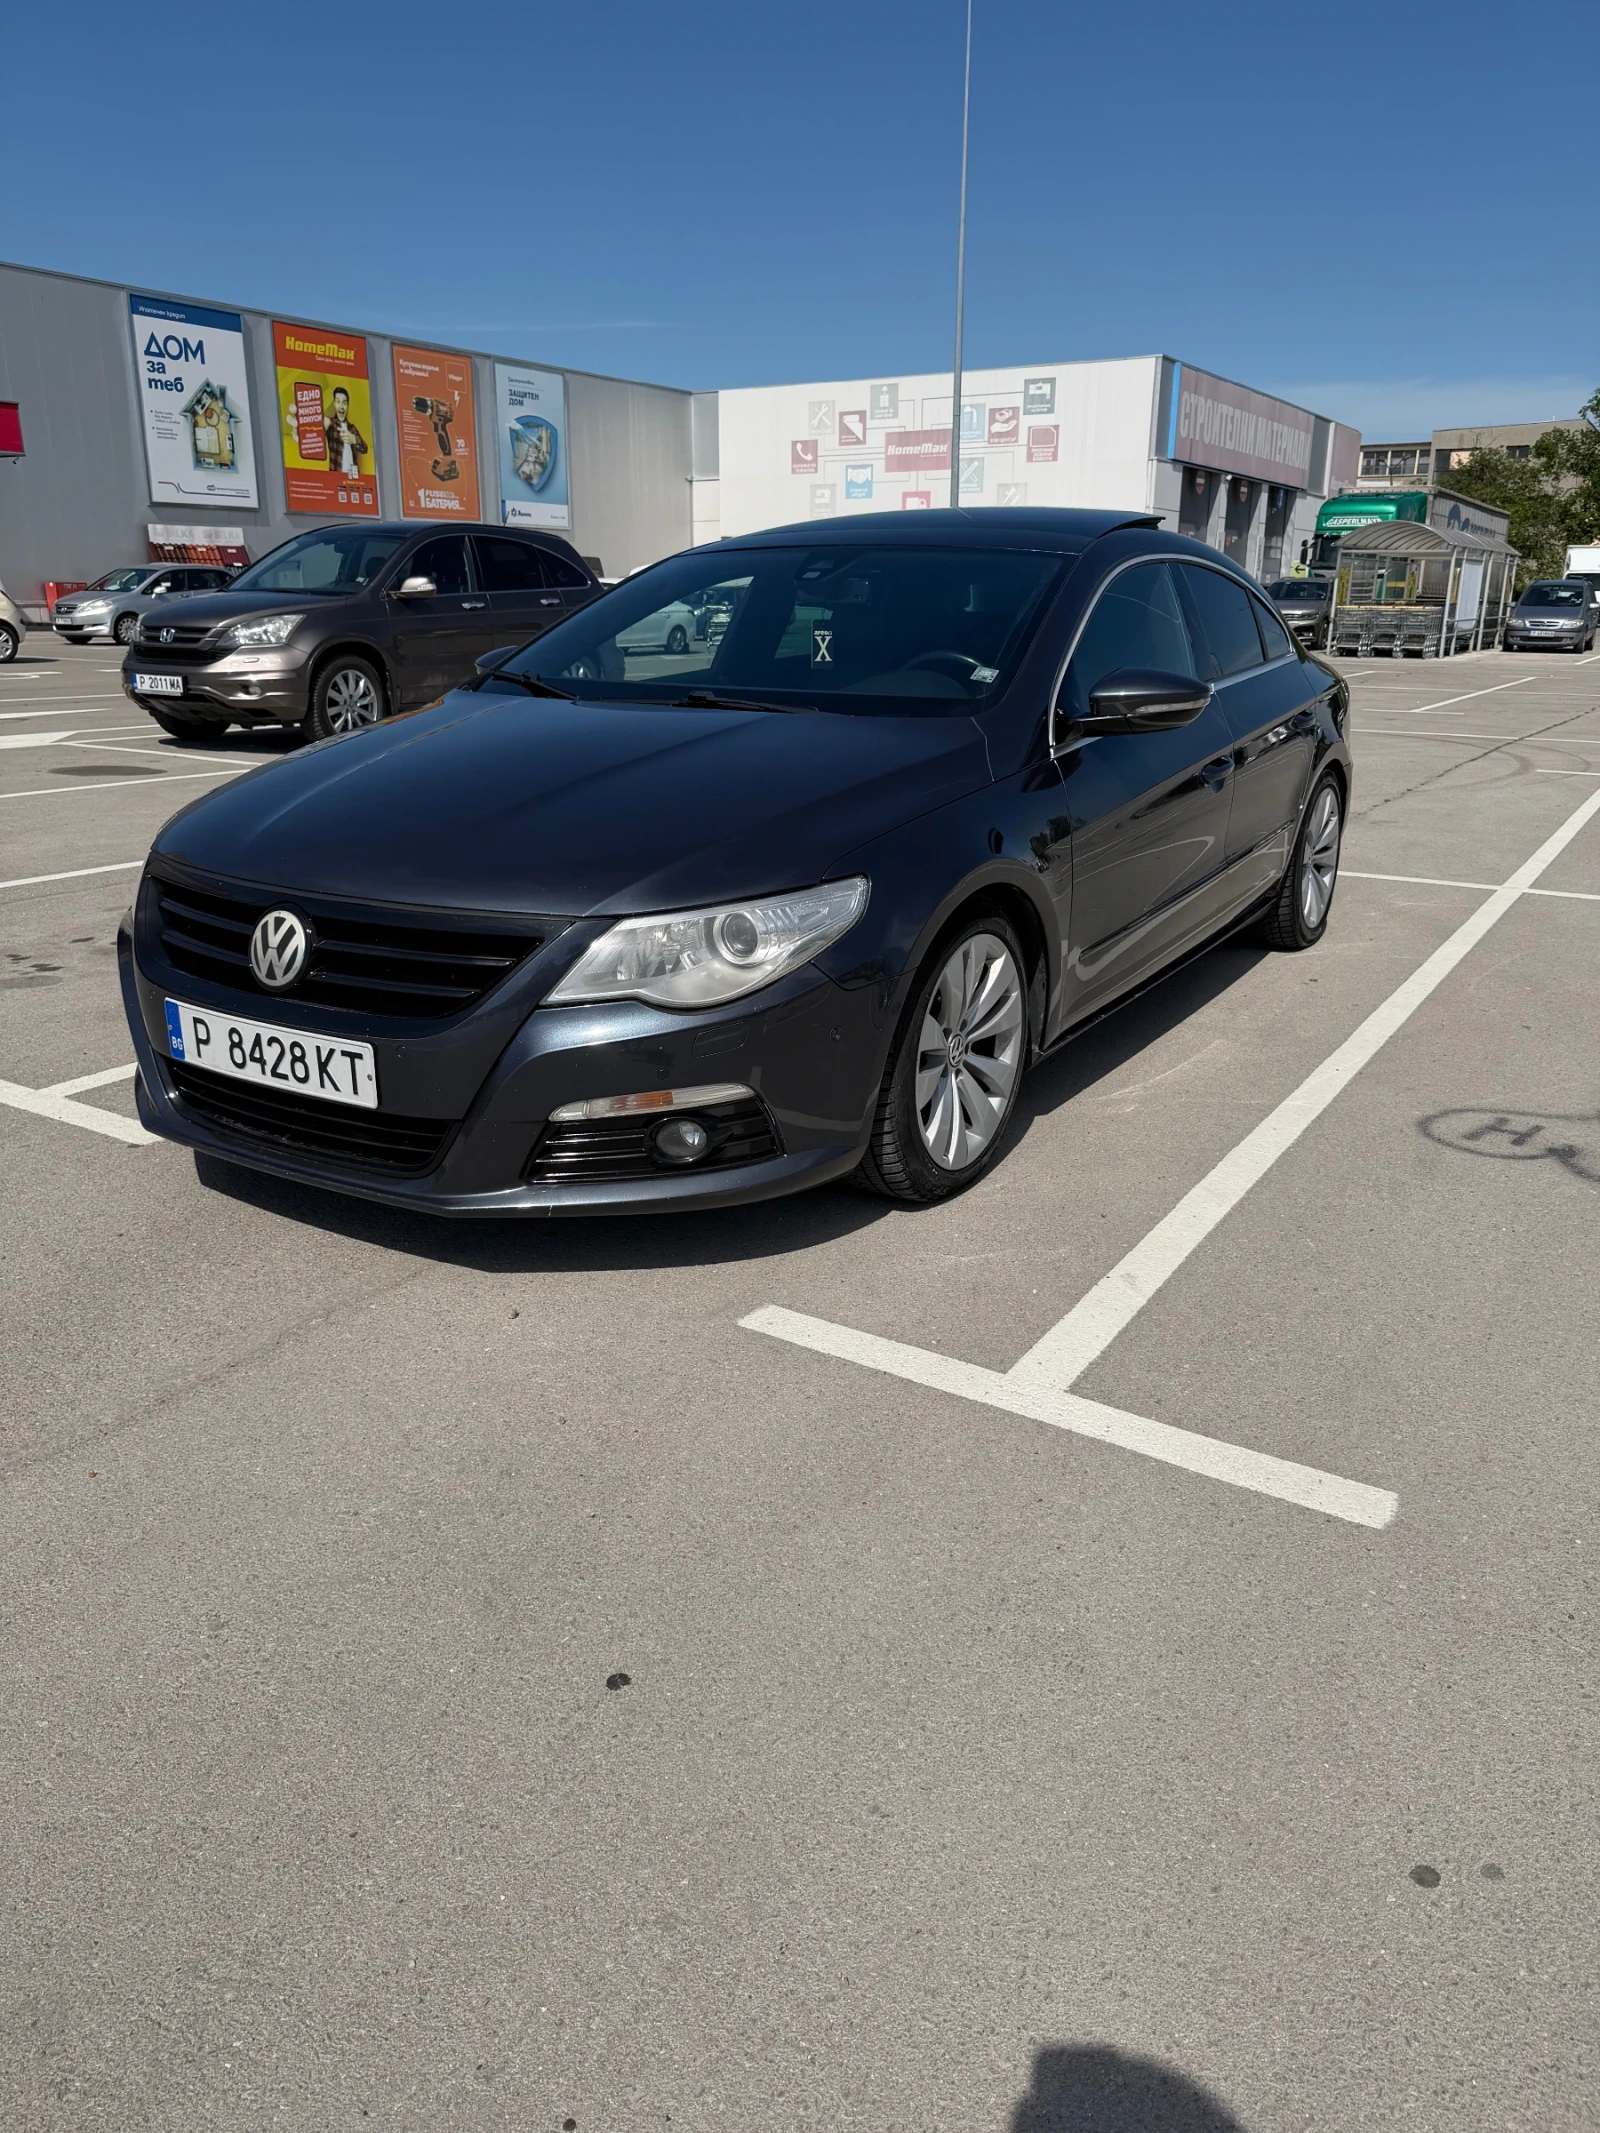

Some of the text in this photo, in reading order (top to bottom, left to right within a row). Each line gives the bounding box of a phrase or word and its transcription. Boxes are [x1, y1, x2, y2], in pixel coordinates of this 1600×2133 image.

[144, 331, 206, 365] ДОМ
[286, 336, 355, 360] HomeMax
[146, 360, 166, 375] за
[148, 377, 185, 393] теб
[297, 389, 321, 401] ЕДНО
[508, 388, 540, 401] ЗАЩИТЕН
[508, 397, 525, 407] ДОМ
[298, 406, 322, 416] МНОГО
[1179, 390, 1312, 471] СТРОИТЕЛНИ МАТЕРИАЛИ
[887, 443, 948, 456] HomeMax
[425, 498, 460, 510] БАТЕРИЯ
[814, 635, 833, 662] X
[171, 1035, 184, 1051] BG
[192, 1016, 211, 1058] P
